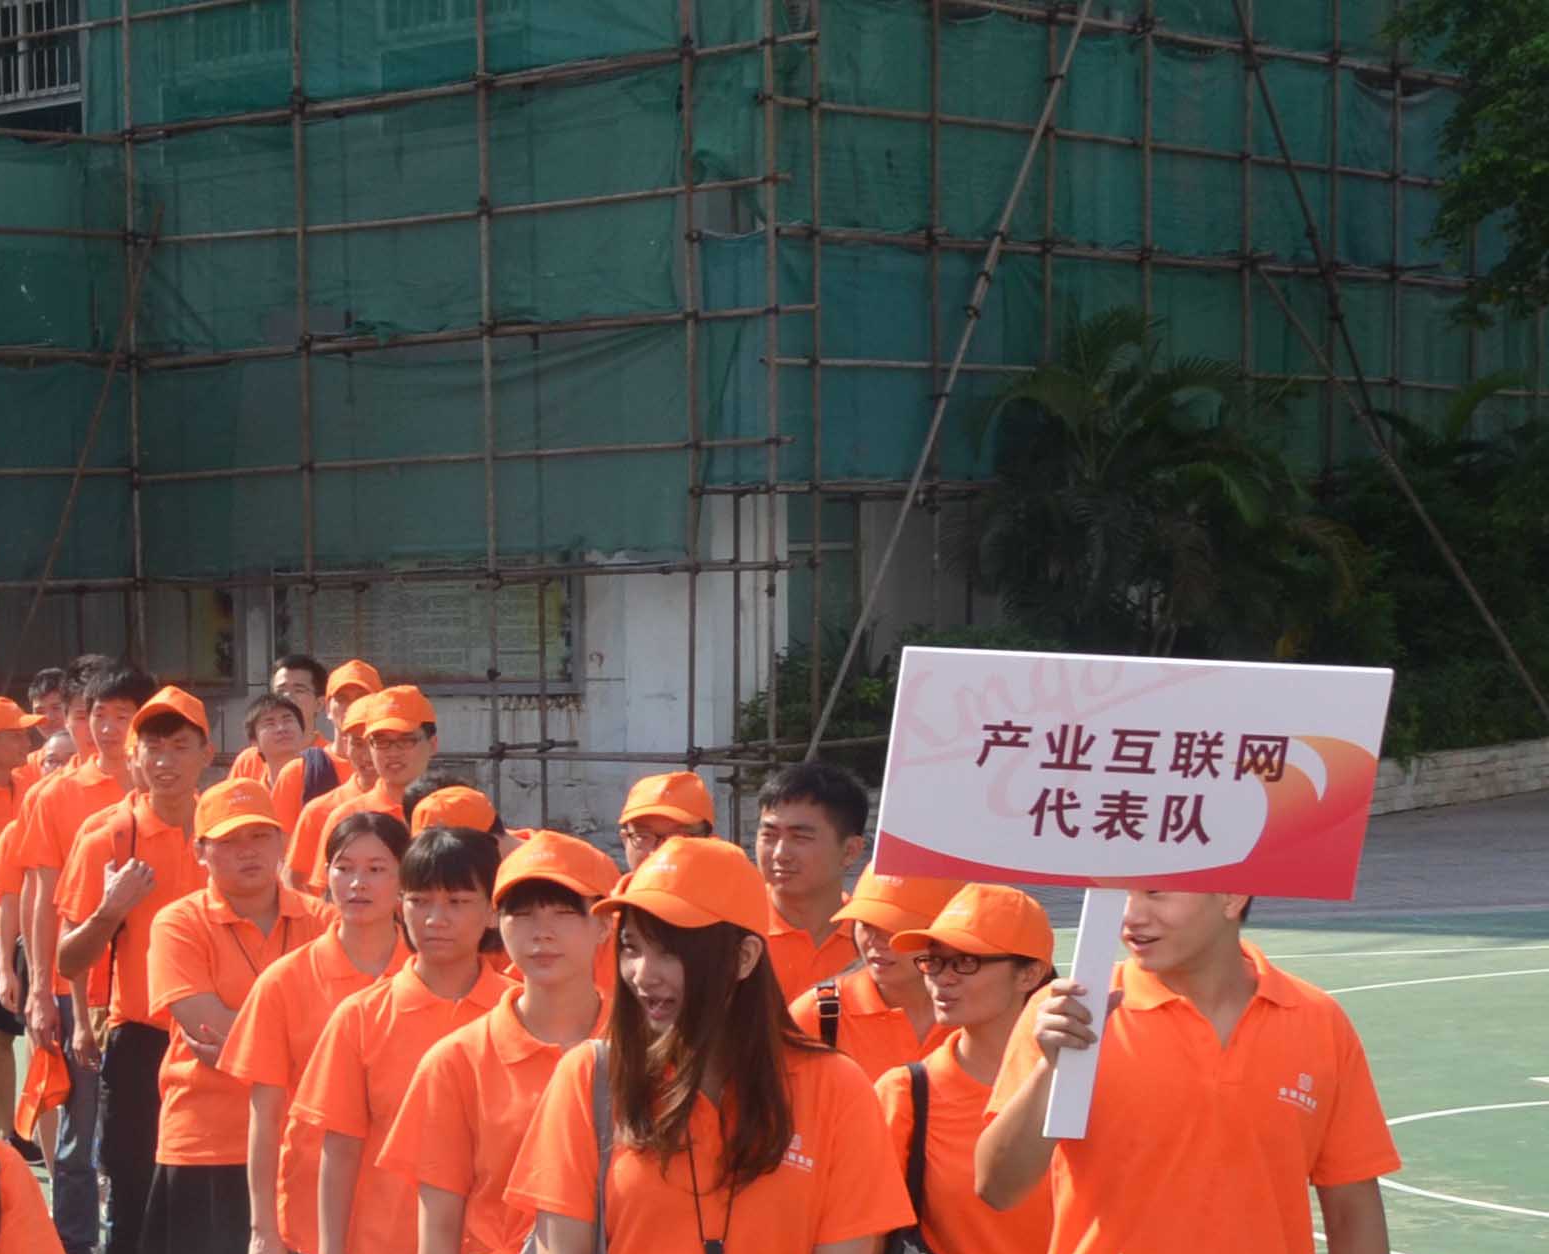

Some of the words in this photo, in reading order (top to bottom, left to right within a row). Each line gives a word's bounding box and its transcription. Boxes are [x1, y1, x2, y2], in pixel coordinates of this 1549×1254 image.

[974, 720, 1290, 783] 产业互联网
[1028, 786, 1213, 845] 代表队
